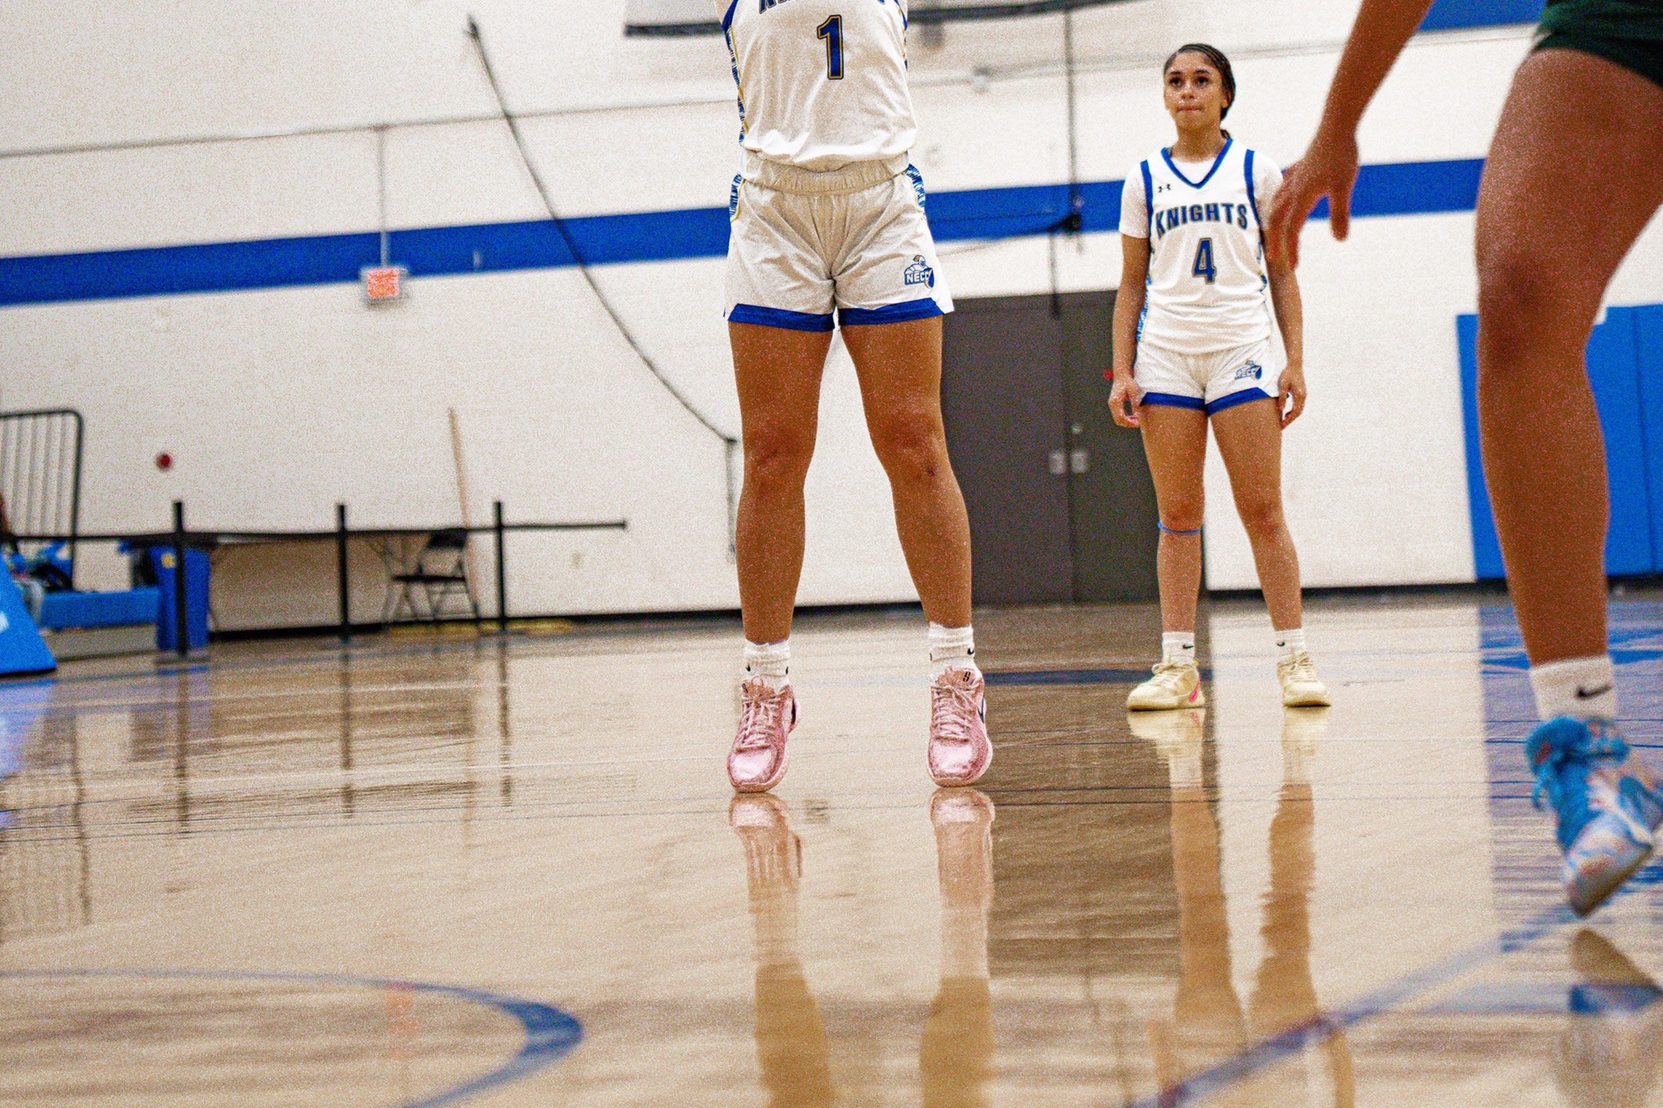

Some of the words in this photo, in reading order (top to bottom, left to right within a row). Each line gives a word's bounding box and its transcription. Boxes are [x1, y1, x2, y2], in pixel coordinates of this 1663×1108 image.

[817, 14, 844, 80] 1
[1155, 202, 1248, 240] KNIGHTS
[1191, 237, 1217, 285] 4
